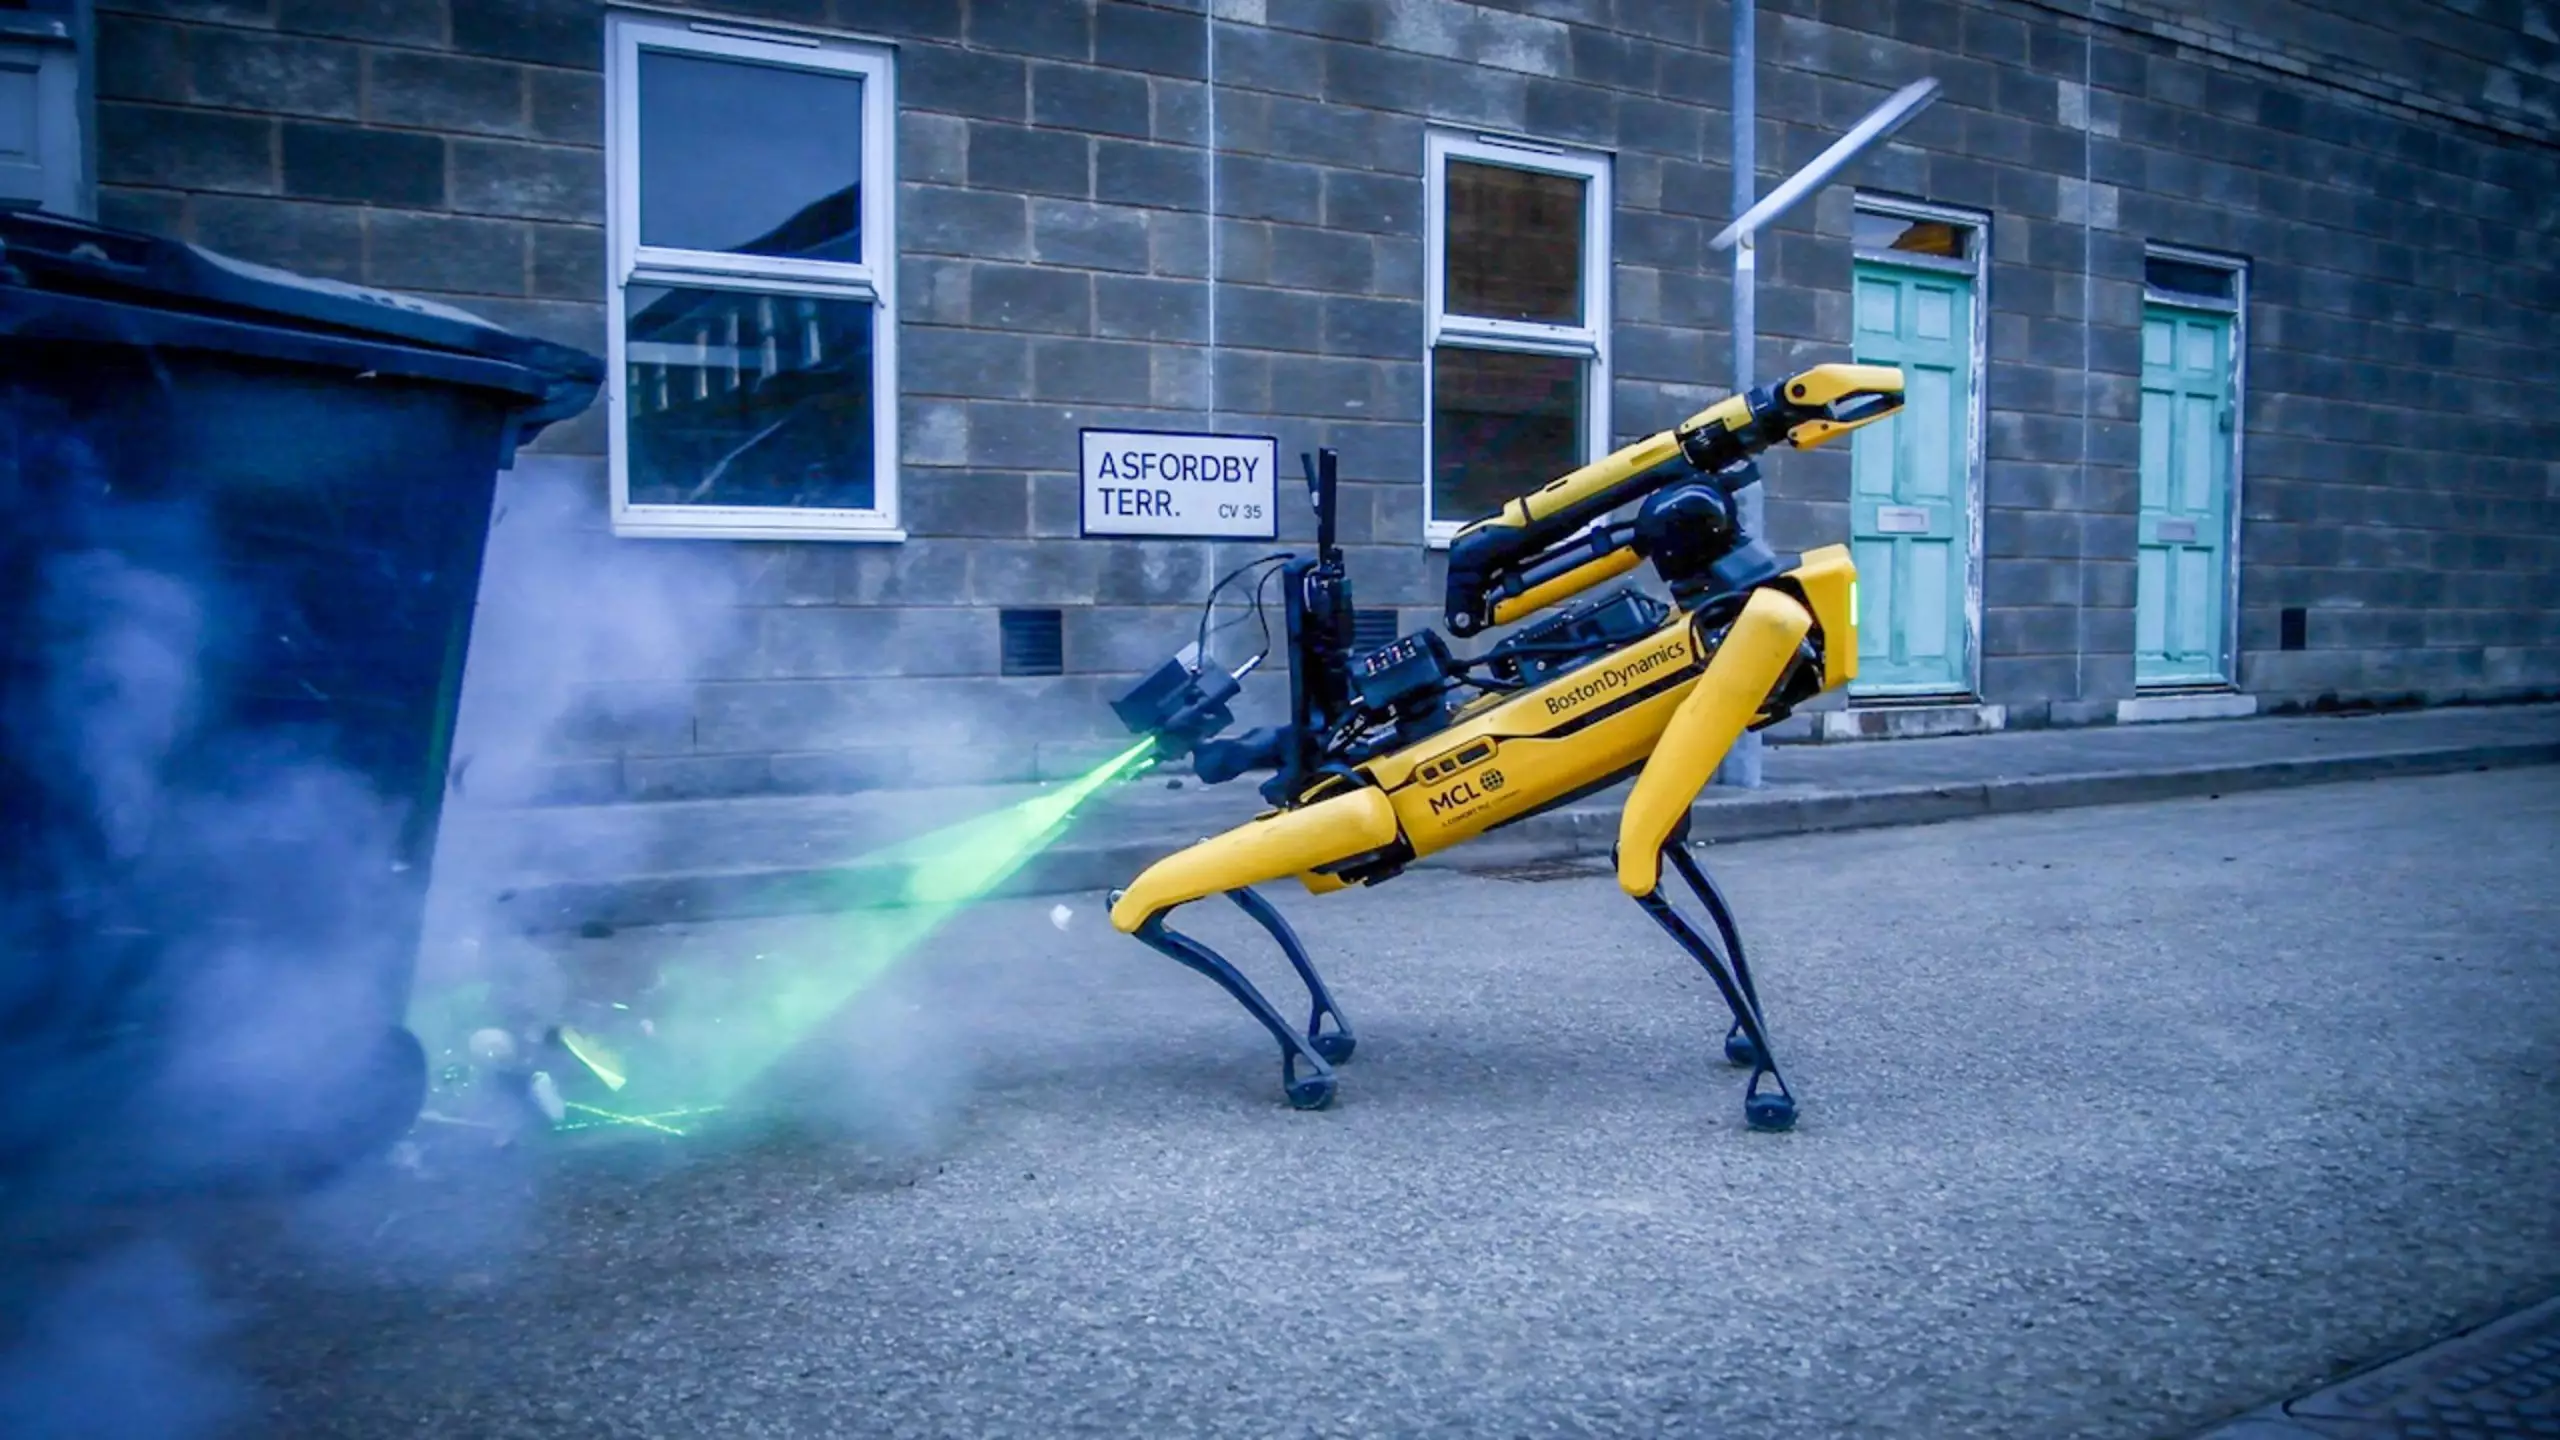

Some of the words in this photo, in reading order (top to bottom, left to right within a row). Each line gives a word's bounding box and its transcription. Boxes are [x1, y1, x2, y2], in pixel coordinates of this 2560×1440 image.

[1098, 451, 1259, 483] ASFORDBY
[1098, 487, 1181, 518] TERR.
[1218, 503, 1239, 519] CV
[1243, 504, 1262, 520] 35
[1429, 782, 1480, 816] MCL
